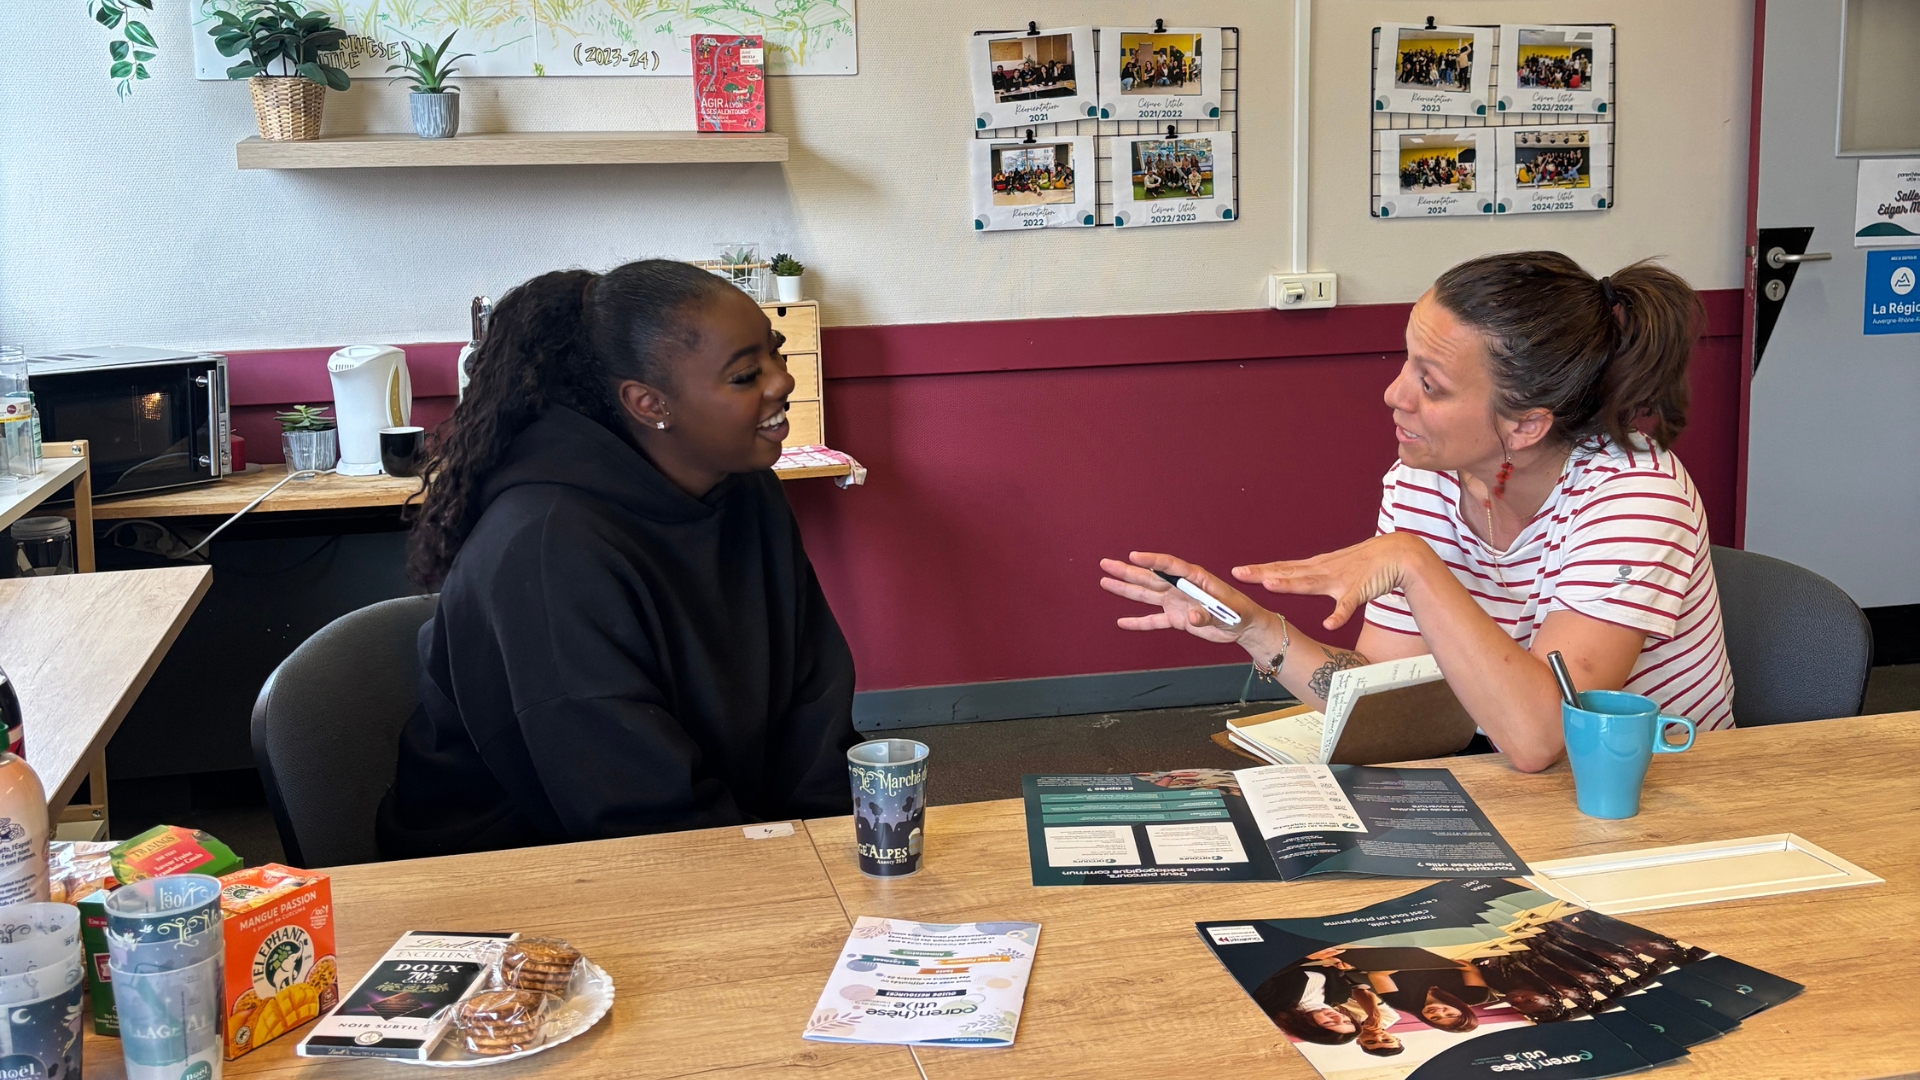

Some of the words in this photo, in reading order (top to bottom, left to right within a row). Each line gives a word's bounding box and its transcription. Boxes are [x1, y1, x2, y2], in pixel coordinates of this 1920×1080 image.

[701, 98, 724, 108] AGIR
[1531, 104, 1574, 112] 2023/2024
[1029, 113, 1048, 122] 2021
[1138, 109, 1183, 118] 2021/2022
[1531, 202, 1574, 211] 2024/2025
[1878, 203, 1908, 219] Edgar
[1023, 218, 1044, 227] 2022
[1150, 213, 1197, 223] 2022/2023
[1873, 303, 1886, 314] La
[867, 768, 921, 796] Marché
[129, 834, 176, 857] TWININGS
[869, 844, 908, 859] ALPES
[240, 907, 279, 931] MANGUE
[280, 891, 317, 914] PASSION
[1323, 916, 1375, 927] programme
[1402, 915, 1437, 923] Trouver
[253, 926, 305, 977] ELEPHANT
[396, 951, 482, 959] EXCELLENC
[394, 963, 463, 973] DOUX
[407, 971, 439, 981] 70%
